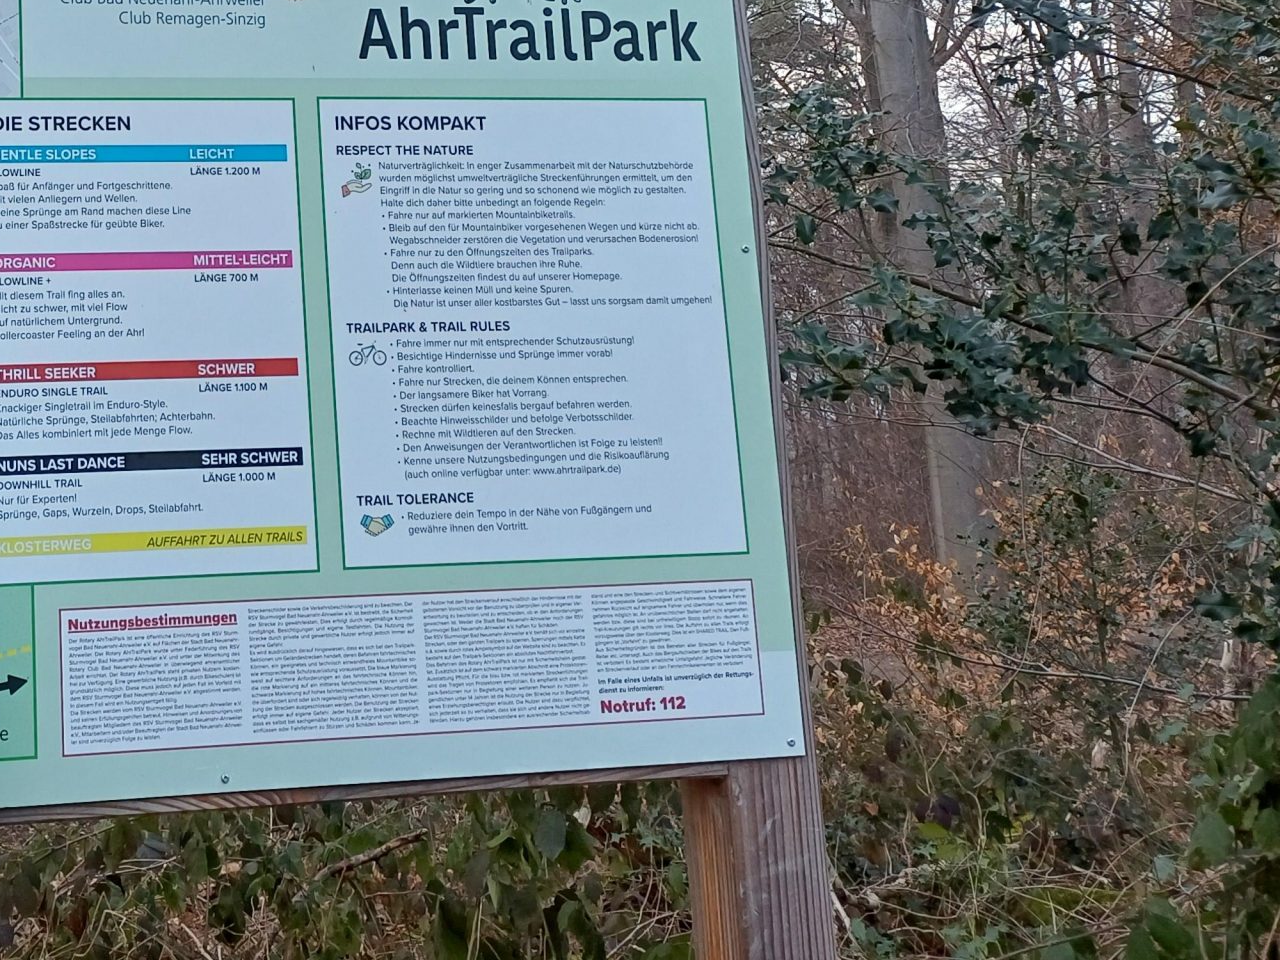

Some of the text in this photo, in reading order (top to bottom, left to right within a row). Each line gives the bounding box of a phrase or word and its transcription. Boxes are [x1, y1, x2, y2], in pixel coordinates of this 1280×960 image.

[118, 11, 266, 29] Club Remagen-Sinzig
[359, 6, 702, 62] AhrTrailPark
[28, 115, 131, 131] STRECKEN
[334, 115, 487, 131] INFOS KOMPAKT
[45, 148, 96, 160] SLOPES
[189, 148, 235, 159] LEICHT
[335, 144, 474, 156] RESPECT THE NATURE
[189, 165, 261, 176] LÄNGE 1.200 M
[378, 173, 693, 184] wurden möglichst umweltverträgliche Streckenführungen ermittelt, um den
[17, 181, 30, 191] für
[31, 181, 75, 192] Anfänger
[76, 181, 94, 191] und
[96, 181, 173, 192] Fortgeschrittene.
[7, 194, 36, 204] vielen
[37, 194, 82, 205] Anliegern
[84, 194, 102, 203] und
[103, 193, 138, 203] Wellen.
[387, 210, 576, 220] Fahre nur auf markierten Mountainbiketrails.
[193, 253, 288, 265] MITTEL-LEICHT
[194, 272, 259, 283] LÄNGE 700 M
[392, 284, 573, 295] Hinterlasse keinen Müll und keine Spuren.
[10, 317, 65, 326] natürlichem
[67, 315, 123, 327] Untergrund.
[345, 320, 511, 333] TRAILPARK & TRAIL RULES
[57, 329, 92, 340] Feeling
[93, 330, 106, 338] an
[107, 328, 124, 338] der
[125, 327, 145, 337] Ahr!
[396, 348, 613, 362] Besichtige Hindernisse und Sprünge immer vorab!
[44, 366, 96, 379] SEEKER
[198, 362, 255, 375] SCHWER
[41, 387, 78, 397] SINGLE
[79, 386, 108, 396] TRAIL
[198, 381, 268, 393] LÄNGE 1.100 M
[44, 401, 91, 413] Singletrail
[92, 400, 105, 410] im
[106, 399, 168, 410] Enduro-Style.
[39, 458, 74, 471] LAST
[77, 456, 125, 469] DANCE
[201, 451, 298, 465] SEHR SCHWER
[53, 478, 83, 488] TRAIL
[202, 471, 276, 483] LÄNGE 1.000 M
[16, 495, 30, 505] für
[31, 493, 77, 505] Experten!
[355, 492, 474, 506] TRAIL TOLERANCE
[42, 508, 70, 519] Gaps,
[71, 506, 113, 516] Wurzeln,
[115, 505, 147, 515] Drops,
[148, 502, 204, 513] Steilabfahrt.
[407, 521, 529, 536] gewähre ihnen den Vortritt.
[146, 530, 303, 547] AUFFAHRT ZU ALLEN TRAILS
[68, 613, 237, 631] Nutzungsbestimmungen
[600, 696, 686, 714] Notruf: 112
